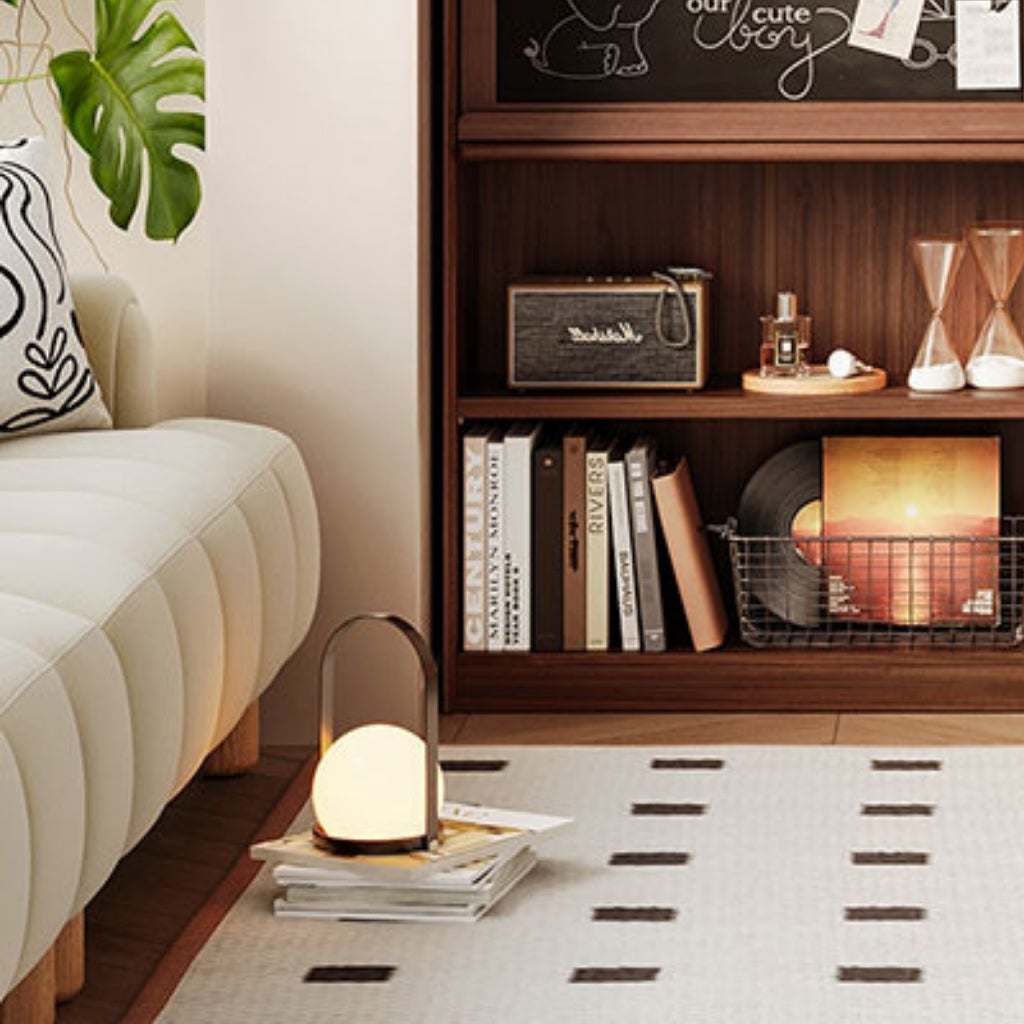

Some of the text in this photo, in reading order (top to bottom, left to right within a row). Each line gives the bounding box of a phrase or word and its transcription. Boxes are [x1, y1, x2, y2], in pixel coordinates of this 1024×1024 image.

[752, 4, 812, 24] cute
[588, 456, 605, 534] RIVERS
[466, 447, 485, 645] CENTURY
